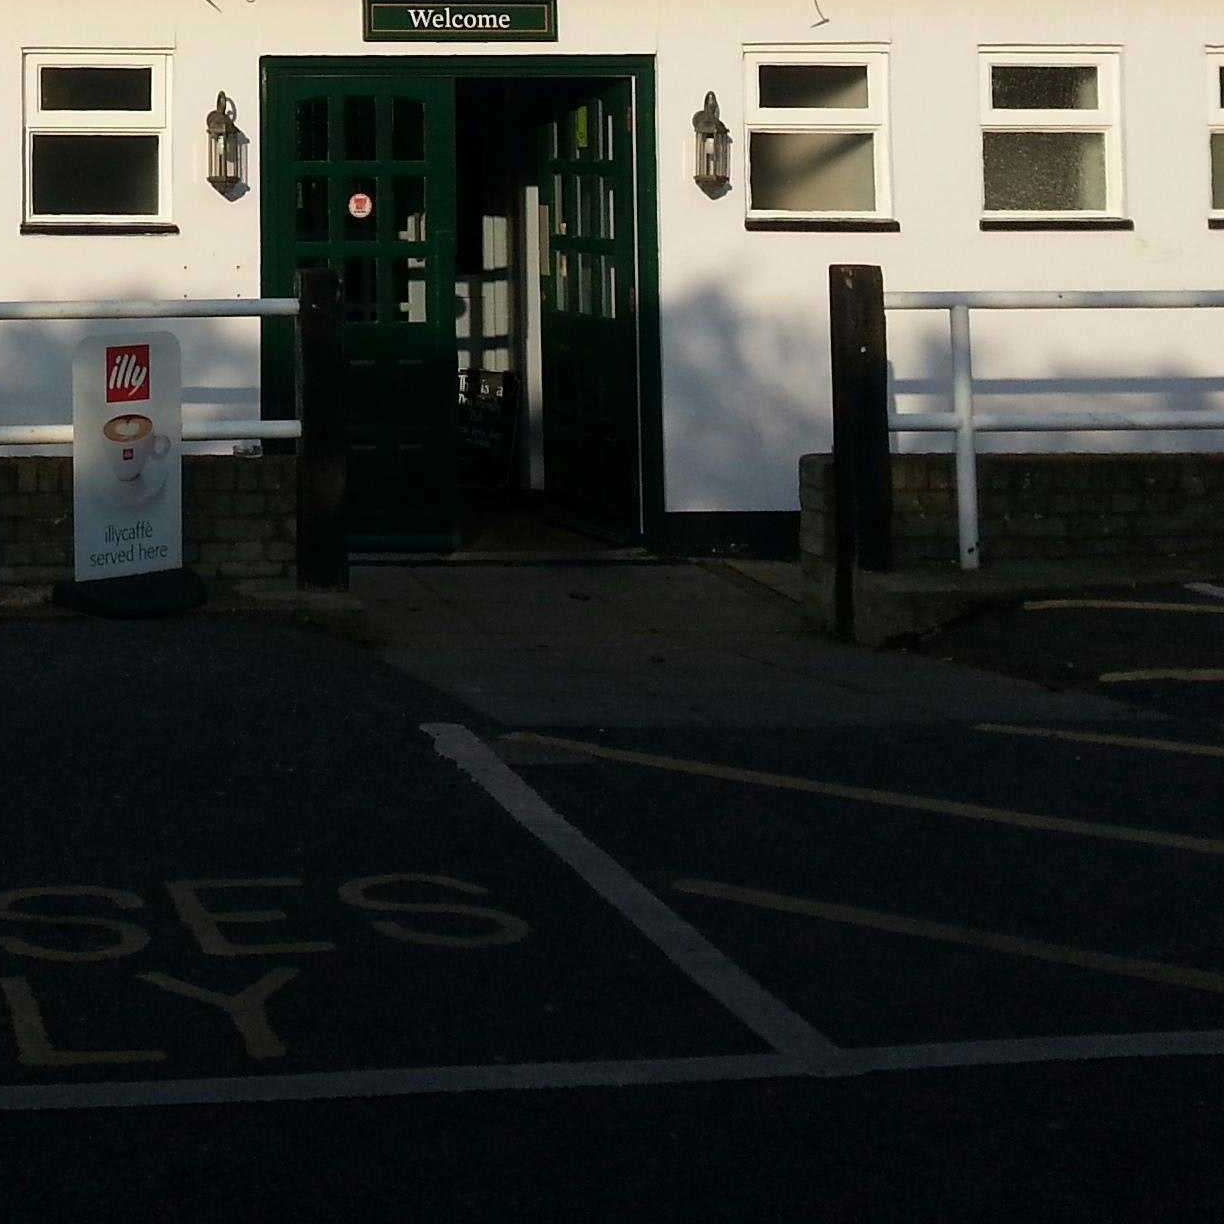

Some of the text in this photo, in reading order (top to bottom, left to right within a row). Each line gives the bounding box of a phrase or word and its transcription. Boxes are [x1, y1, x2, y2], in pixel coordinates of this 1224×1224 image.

[408, 7, 511, 28] Welcome
[108, 353, 147, 397] illy
[89, 541, 168, 568] served here
